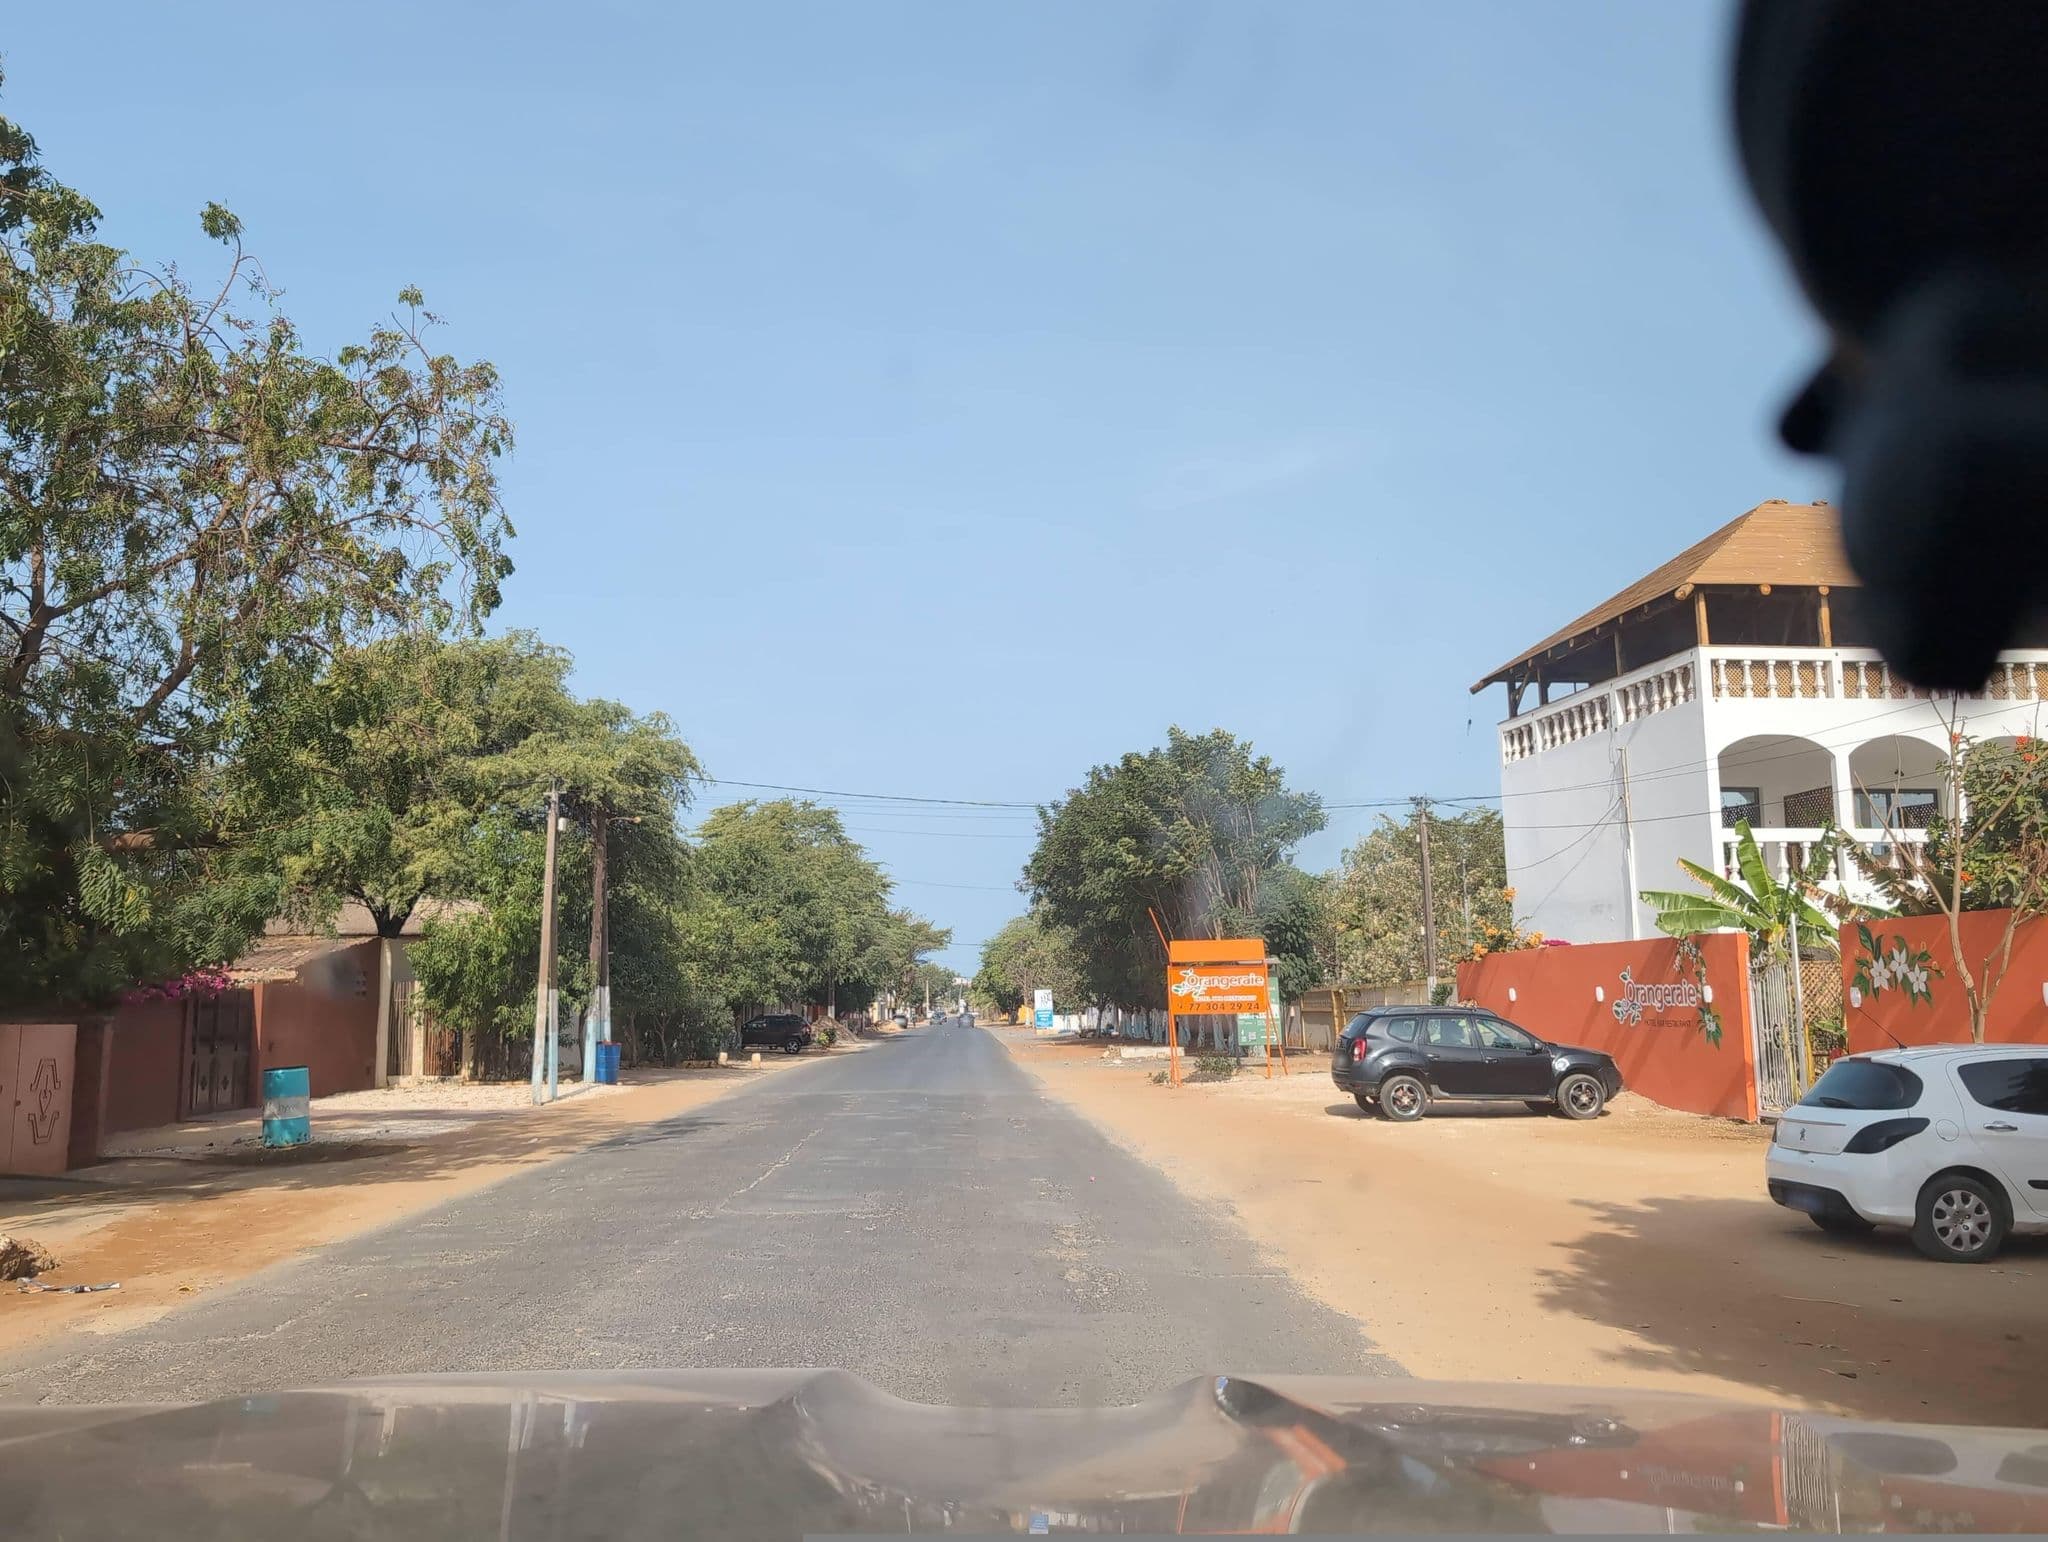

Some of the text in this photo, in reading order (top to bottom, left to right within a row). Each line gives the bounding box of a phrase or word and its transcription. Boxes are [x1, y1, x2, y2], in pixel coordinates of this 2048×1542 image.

[1187, 973, 1264, 989] Orangeraie
[1625, 979, 1697, 1012] Orangeraie
[1230, 1002, 1243, 1010] 29
